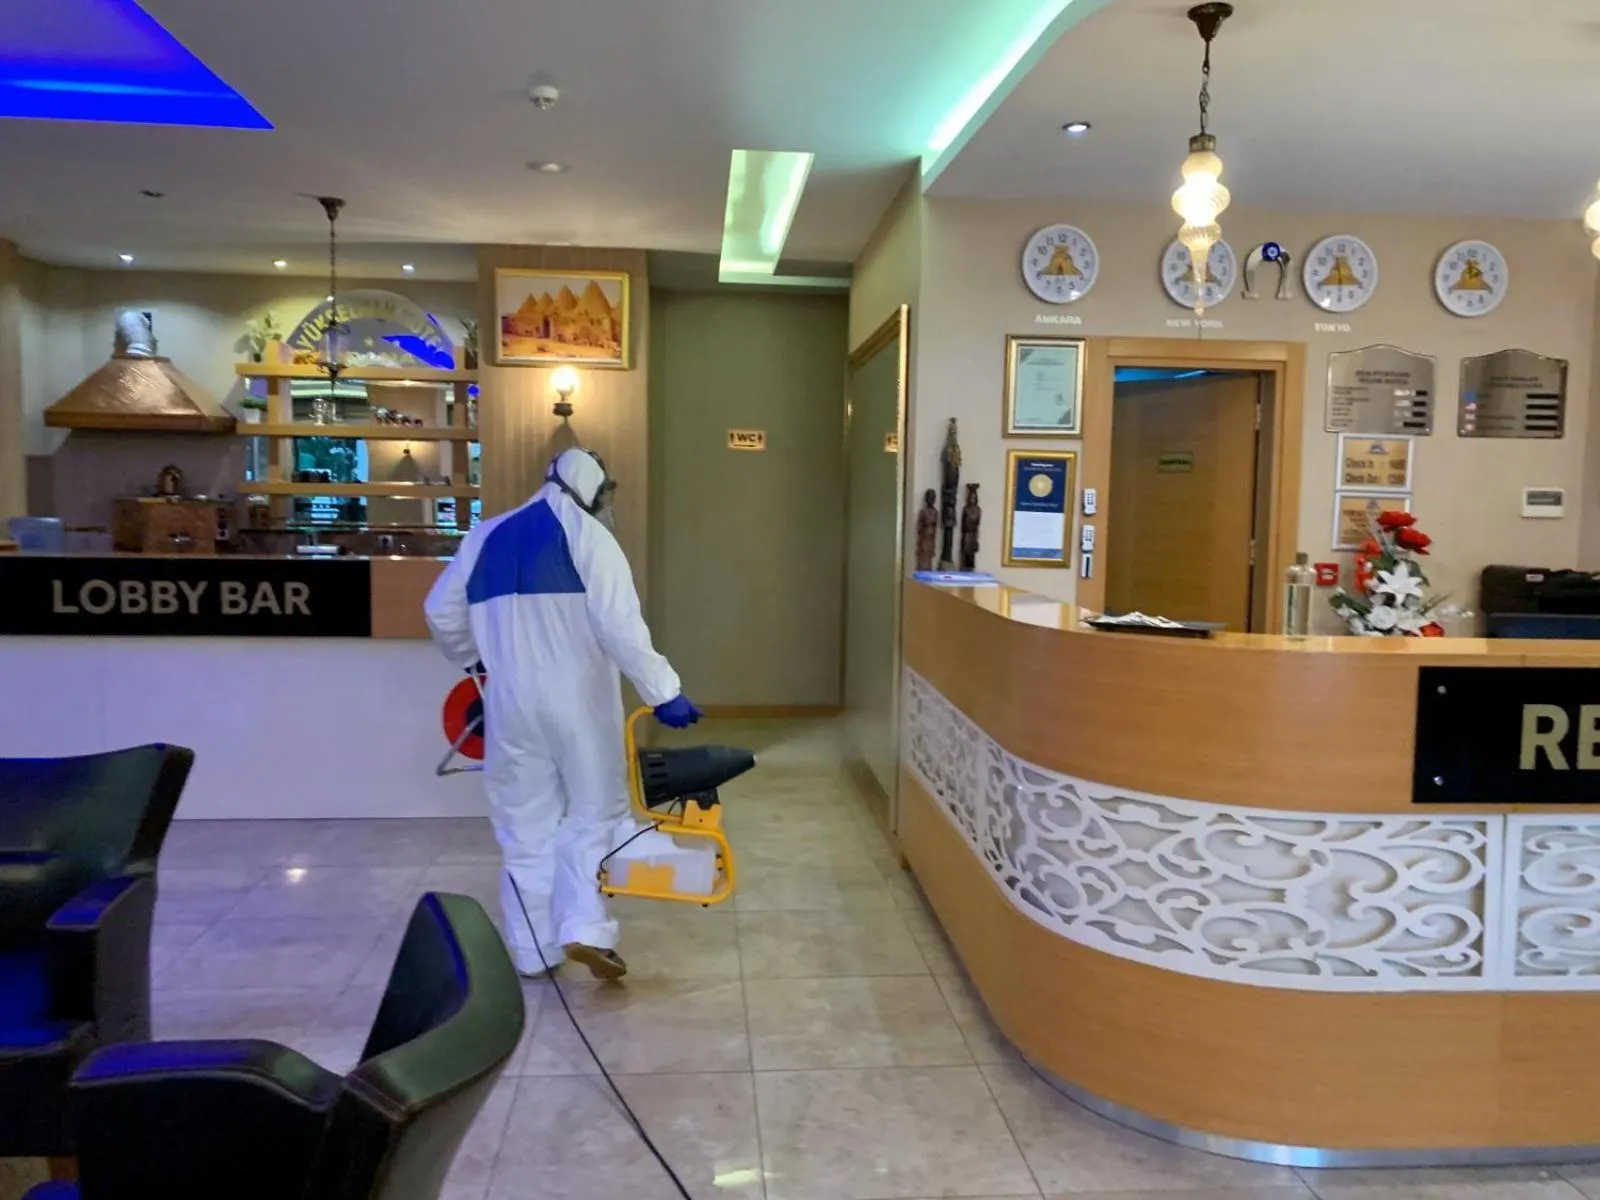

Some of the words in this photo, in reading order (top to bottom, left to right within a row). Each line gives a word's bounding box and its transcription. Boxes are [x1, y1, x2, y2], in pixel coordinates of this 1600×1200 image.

[1034, 314, 1082, 325] ANKARA
[1314, 322, 1352, 333] TOKYO
[736, 432, 757, 443] WC
[52, 579, 208, 615] LOBBY
[219, 580, 312, 615] BAR
[1519, 703, 1600, 770] RE
